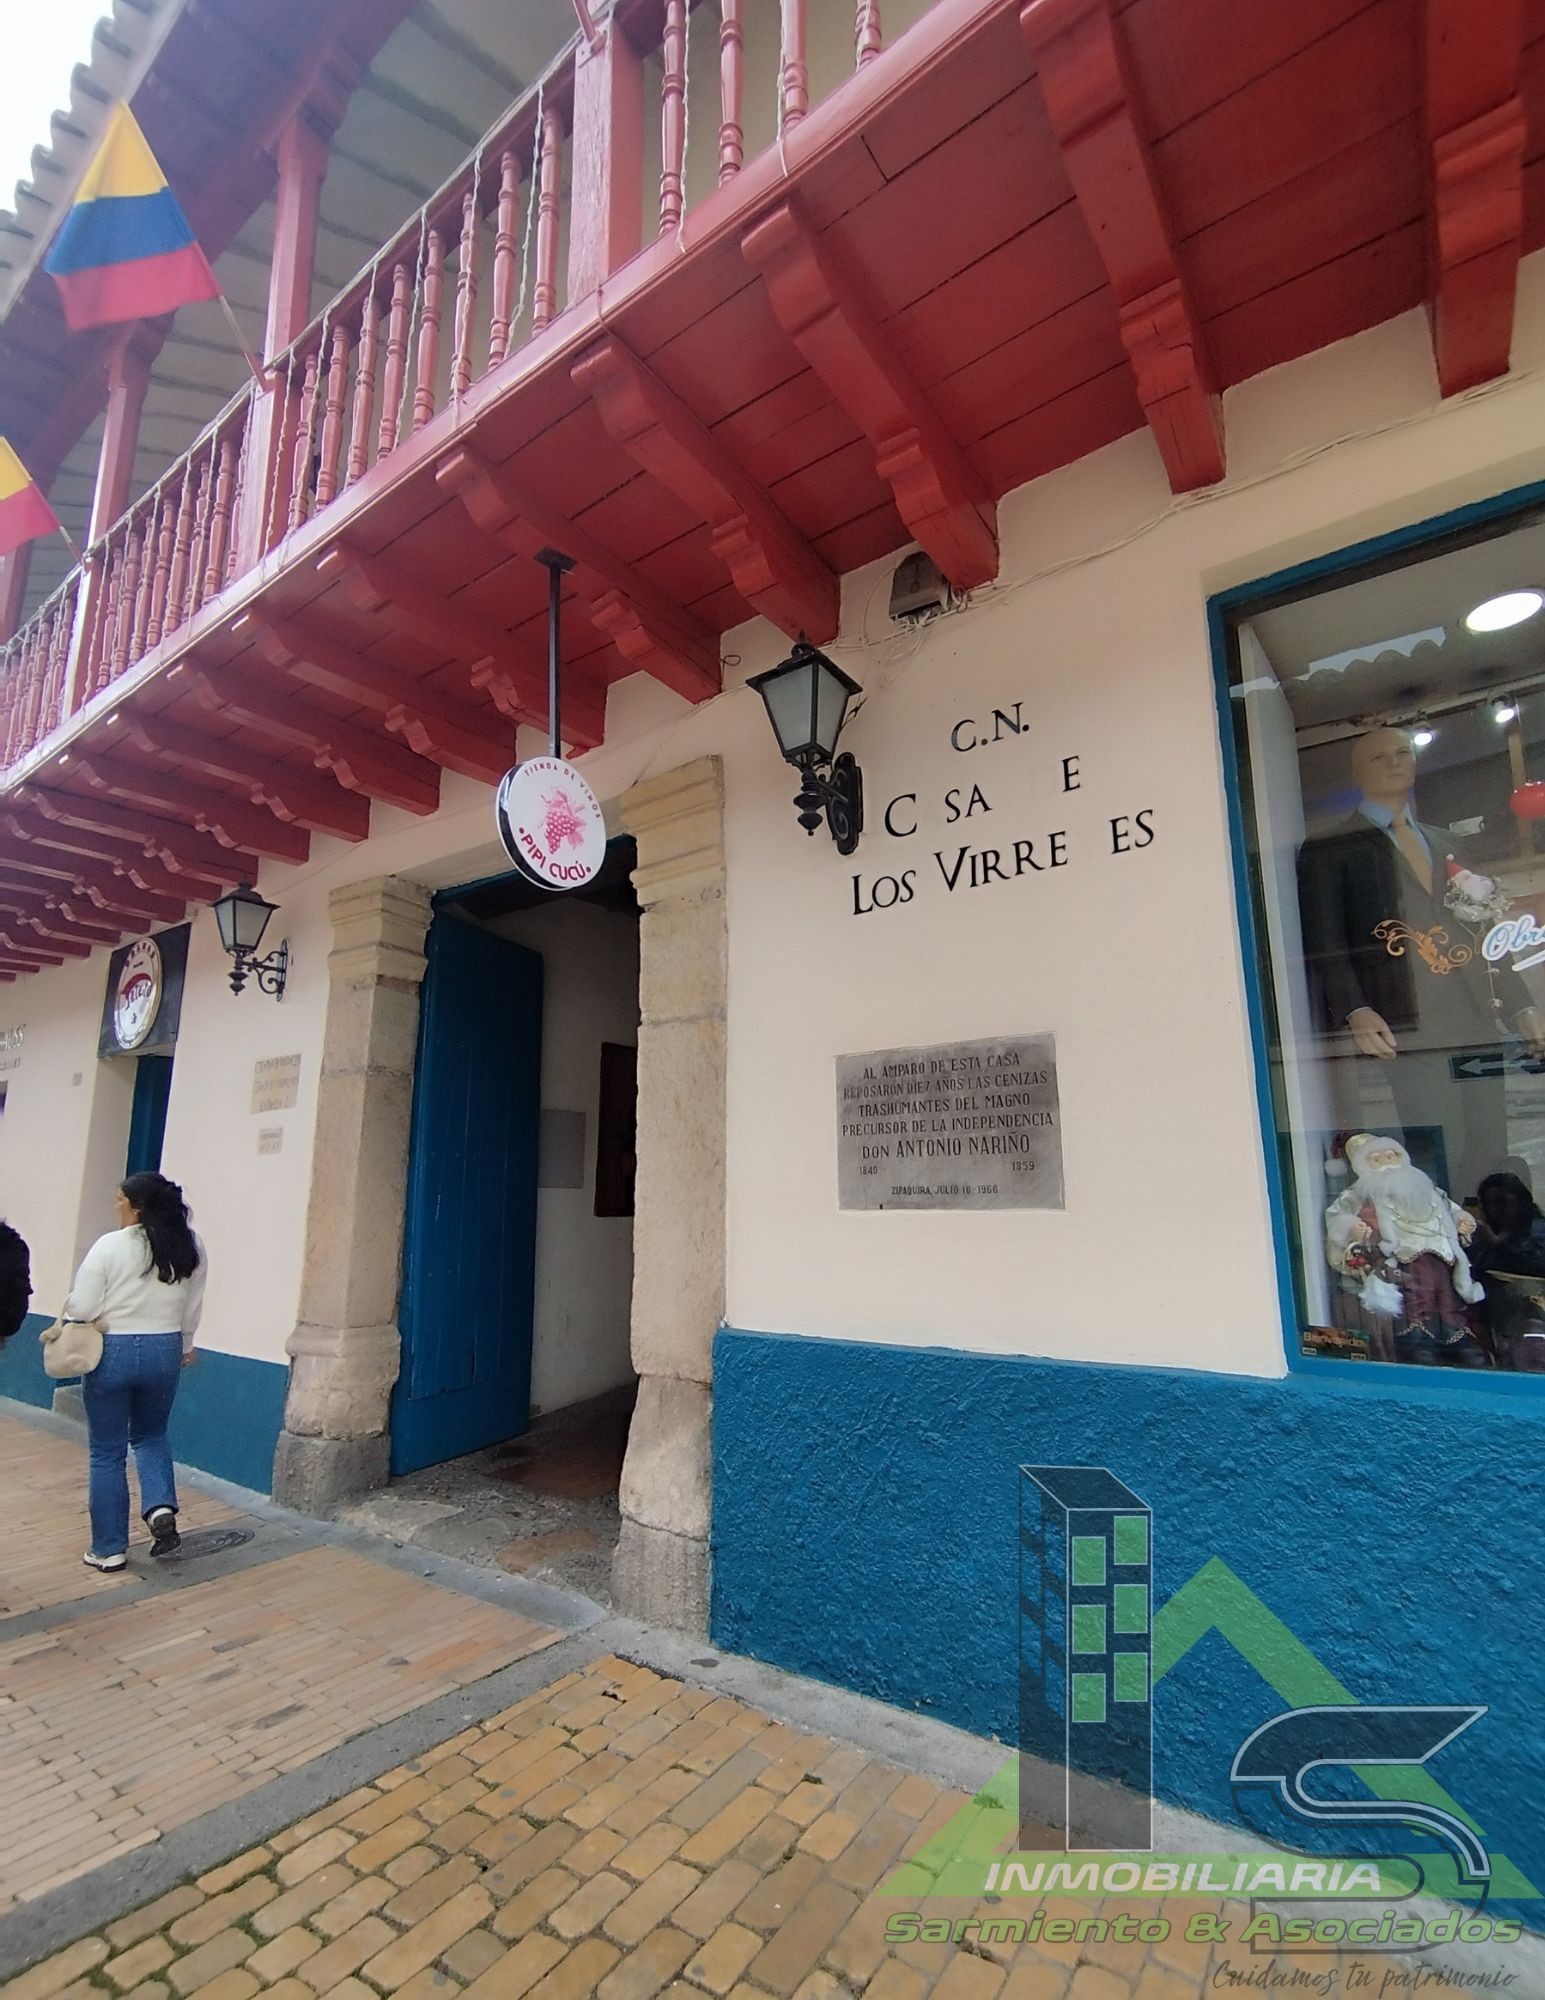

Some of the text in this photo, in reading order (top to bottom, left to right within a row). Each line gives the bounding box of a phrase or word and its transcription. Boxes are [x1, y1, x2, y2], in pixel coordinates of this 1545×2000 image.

[951, 702, 1030, 752] C.N.
[525, 762, 600, 818] TIENDA DE VINOS
[521, 833, 546, 869] PIPI
[1483, 915, 1545, 959] Obr
[863, 1068, 876, 1080] AL
[882, 1062, 925, 1077] AMPARO
[952, 1056, 981, 1071] ESTA
[987, 1052, 1020, 1068] CASA
[844, 1082, 903, 1099] REPOSARON
[935, 1076, 964, 1092] AÑOS
[995, 1071, 1048, 1087] CENIZAS
[859, 1093, 1030, 1117] TRASHUMANTES DEL MAGNO
[842, 1112, 1053, 1136] PRECURSOR DE LA INDEPENDENCIA
[862, 1131, 1030, 1159] DON ANTONIO NARIÑO
[1012, 1161, 1035, 1171] 1859
[935, 1186, 958, 1195] JULIO
[978, 1185, 998, 1194] 1966
